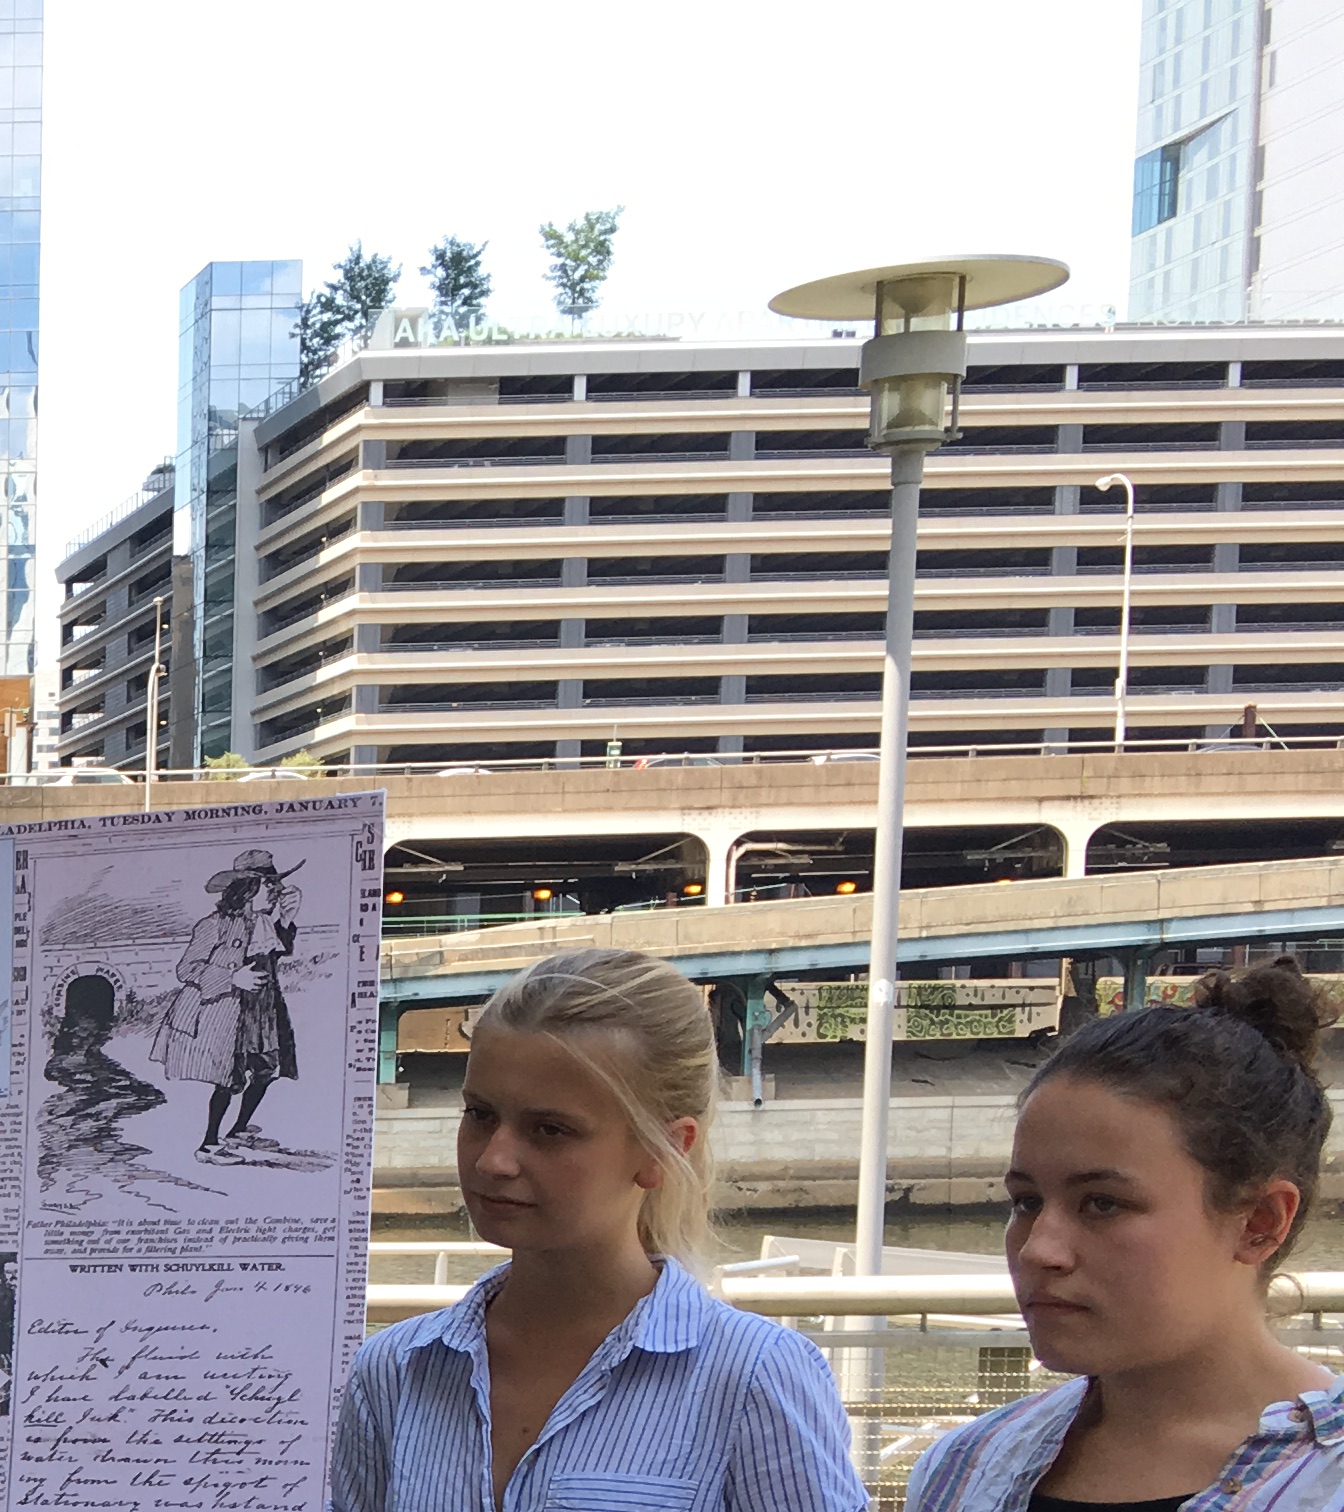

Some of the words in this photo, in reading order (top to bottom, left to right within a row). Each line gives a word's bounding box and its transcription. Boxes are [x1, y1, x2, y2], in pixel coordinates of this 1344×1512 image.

[99, 812, 177, 829] TUESDAY
[183, 806, 269, 823] MORNING,
[274, 796, 363, 815] JANUARY
[68, 1263, 123, 1274] WRITTEN
[127, 1263, 160, 1274] WITH
[163, 1262, 234, 1274] SCHUYLKILL
[95, 1320, 117, 1343] of
[216, 1344, 274, 1360] with
[26, 1366, 98, 1386] which
[138, 1372, 186, 1381] am
[44, 1385, 93, 1402] have
[23, 1406, 67, 1426] kill
[146, 1408, 195, 1426] This
[125, 1430, 163, 1446] the
[279, 1434, 303, 1456] of
[20, 1449, 78, 1465] water
[61, 1469, 118, 1492] from
[129, 1470, 172, 1487] the
[282, 1476, 307, 1498] of
